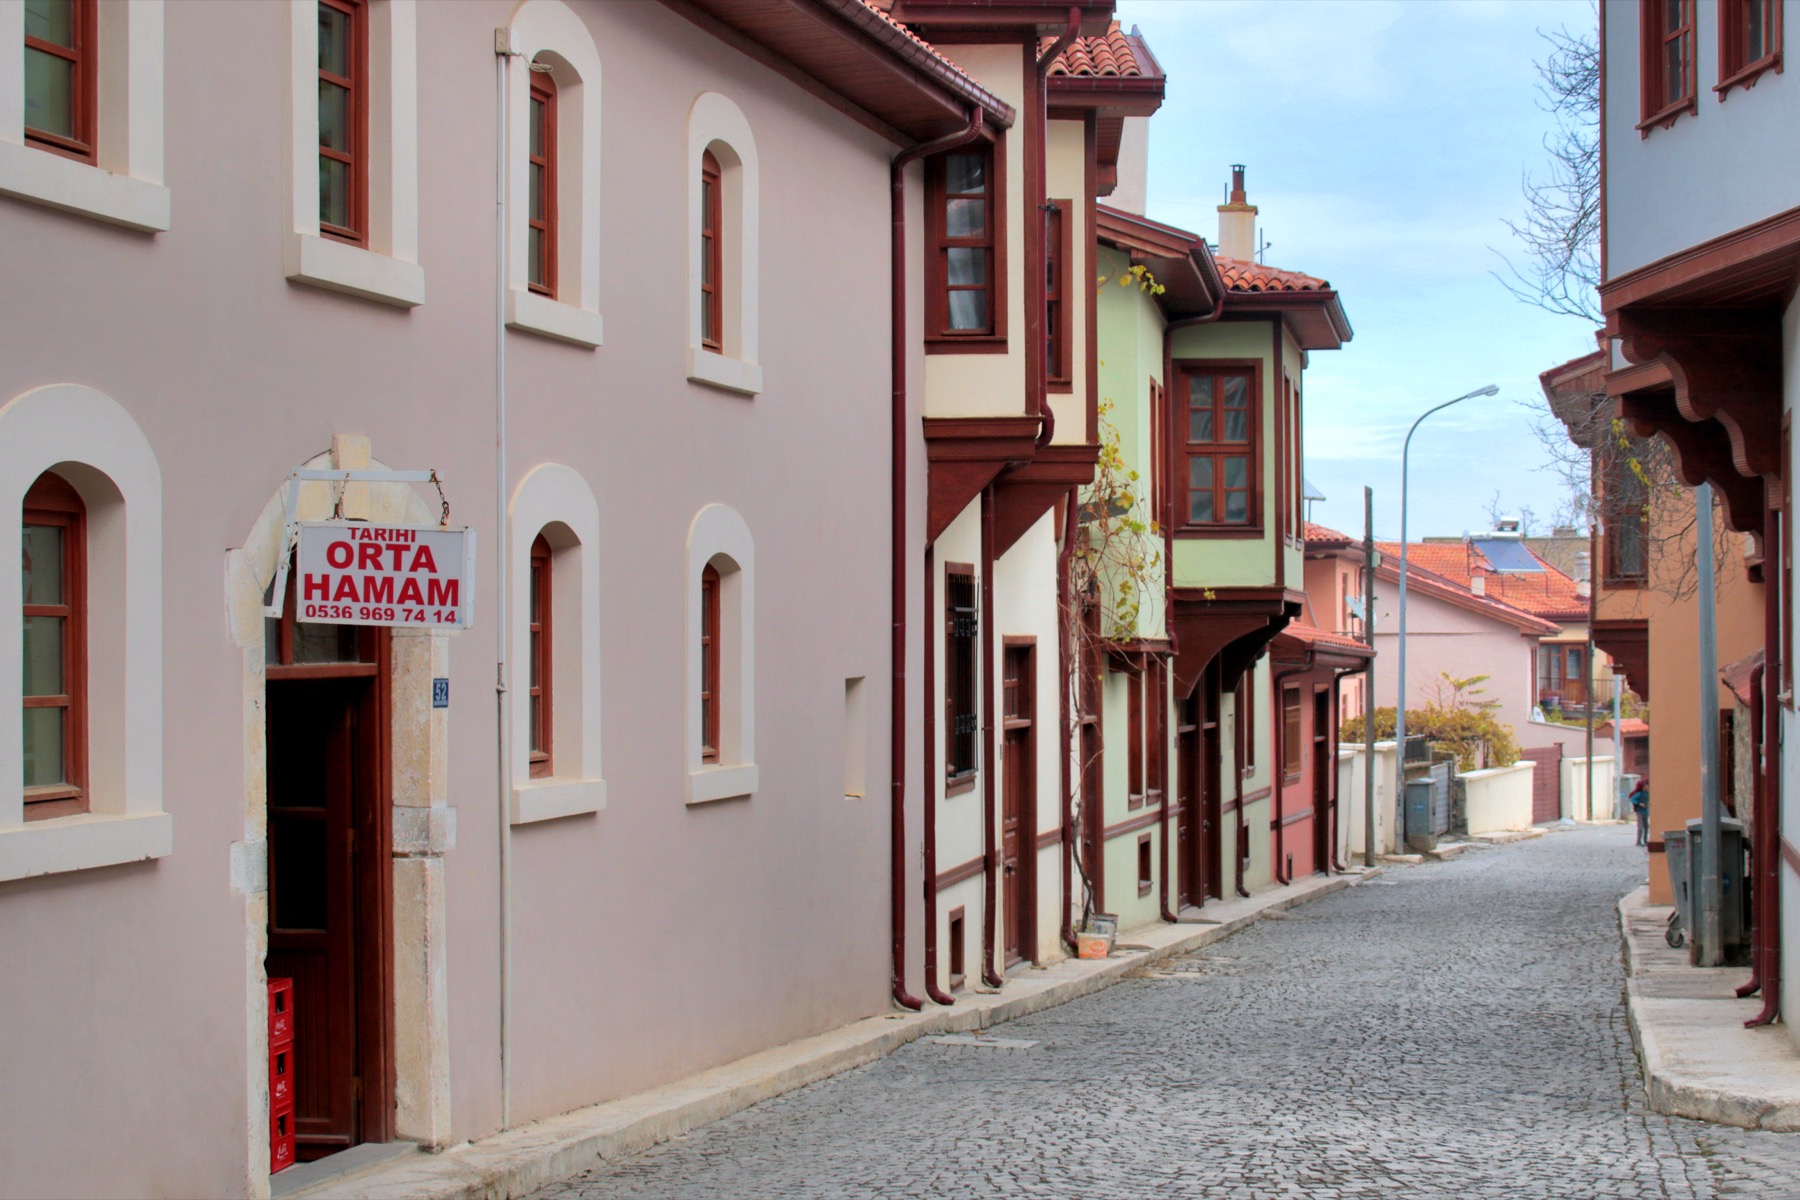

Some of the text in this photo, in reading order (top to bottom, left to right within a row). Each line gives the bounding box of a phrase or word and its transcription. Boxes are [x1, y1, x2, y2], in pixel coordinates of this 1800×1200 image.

[326, 541, 438, 574] ORTA
[304, 573, 459, 607] HAMAM
[305, 604, 457, 624] 0536 969 74 14
[435, 682, 447, 701] 52
